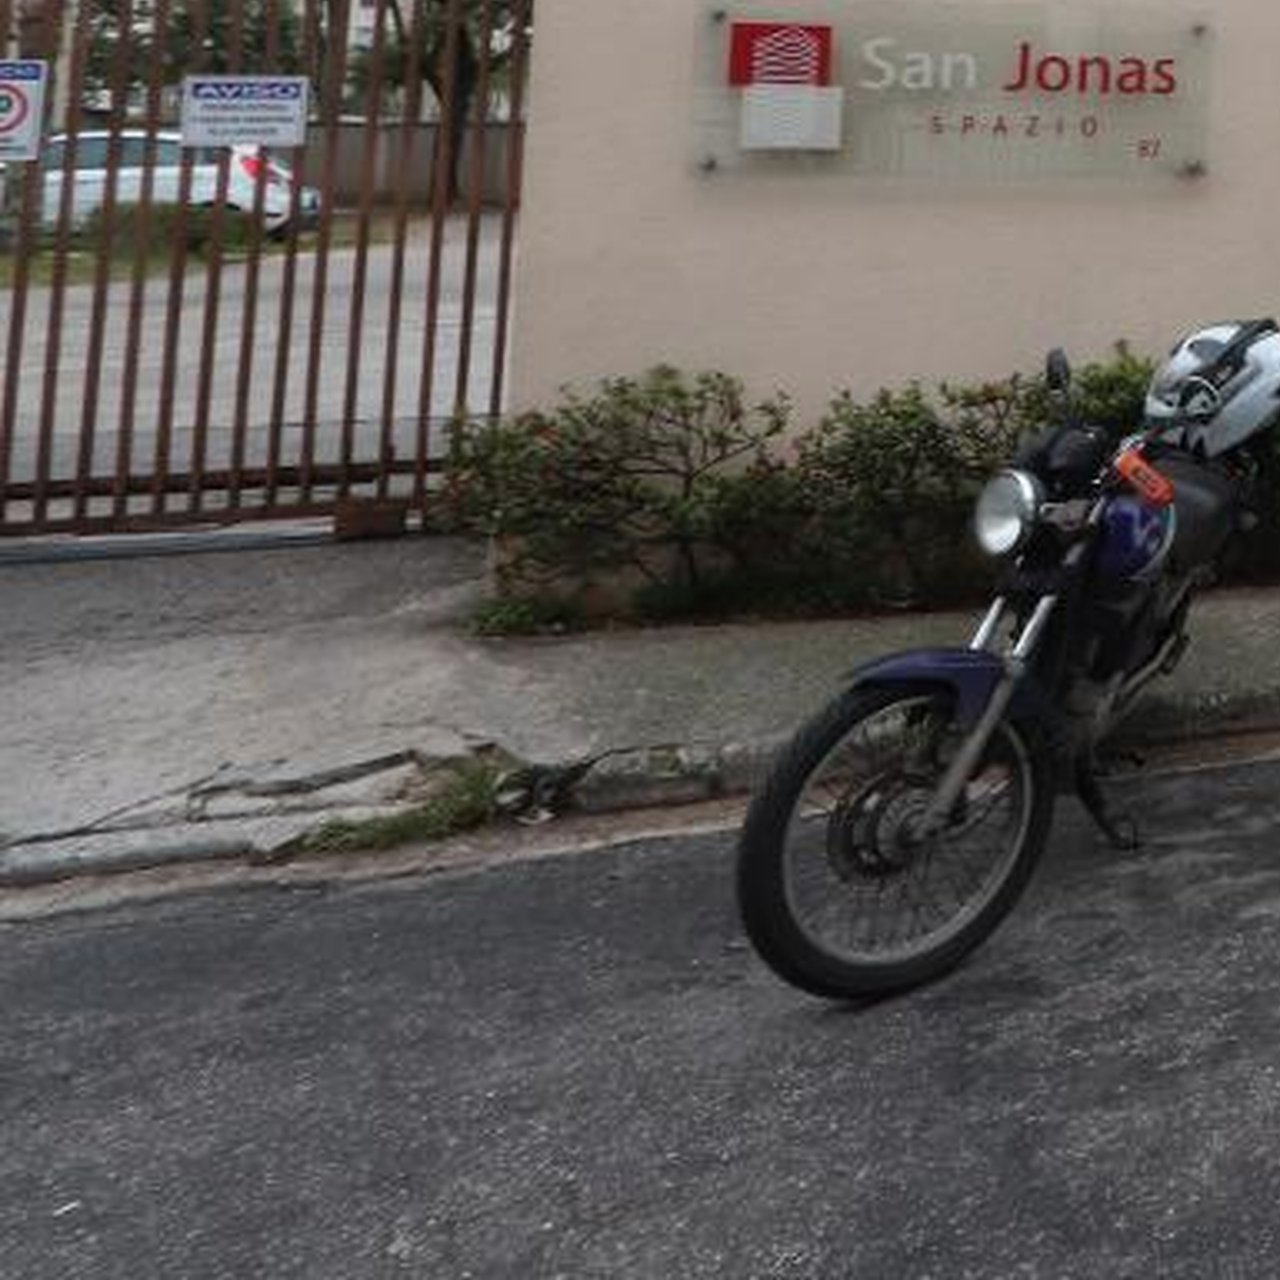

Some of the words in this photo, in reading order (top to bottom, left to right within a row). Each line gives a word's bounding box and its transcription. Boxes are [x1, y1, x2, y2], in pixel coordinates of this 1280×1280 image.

[861, 36, 977, 90] San
[1003, 41, 1177, 95] Jonas
[931, 115, 1099, 137] SPAZIO
